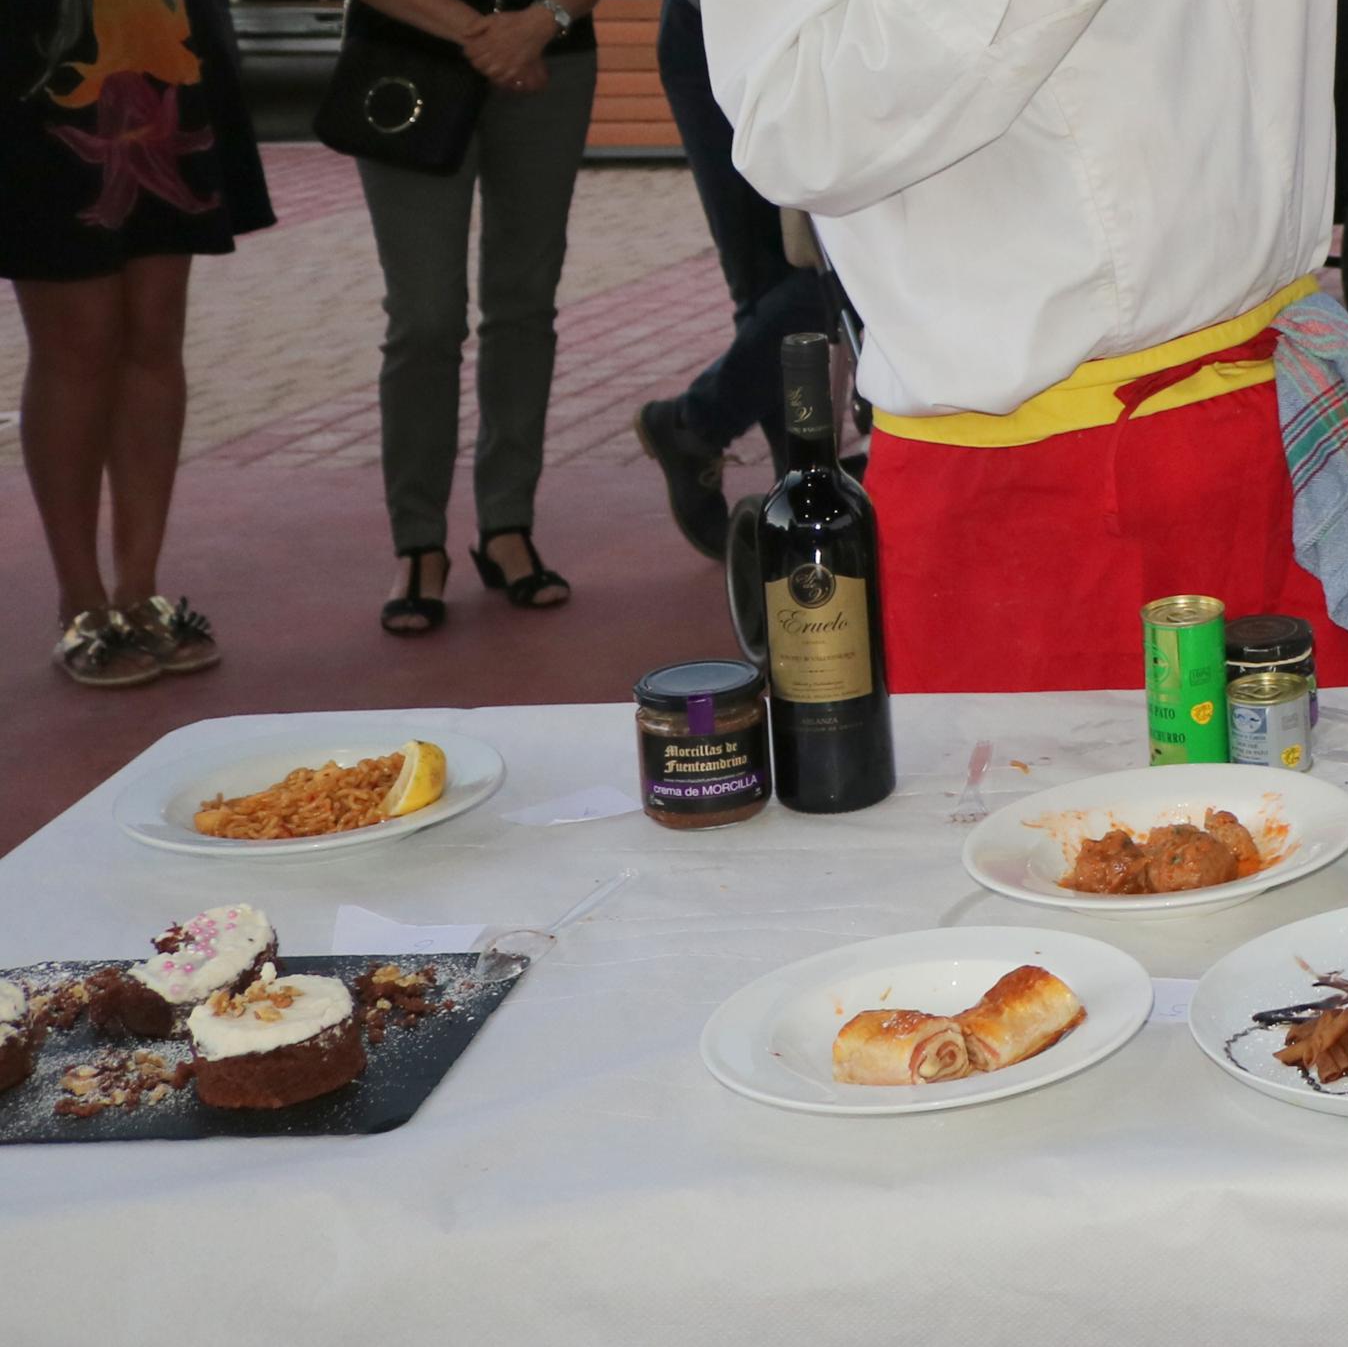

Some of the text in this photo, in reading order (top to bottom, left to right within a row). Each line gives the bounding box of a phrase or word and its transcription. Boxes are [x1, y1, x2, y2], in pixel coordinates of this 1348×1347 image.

[664, 742, 738, 758] Morcillas de
[653, 785, 682, 797] crema
[684, 786, 699, 797] de
[702, 774, 758, 796] MORCILLA
